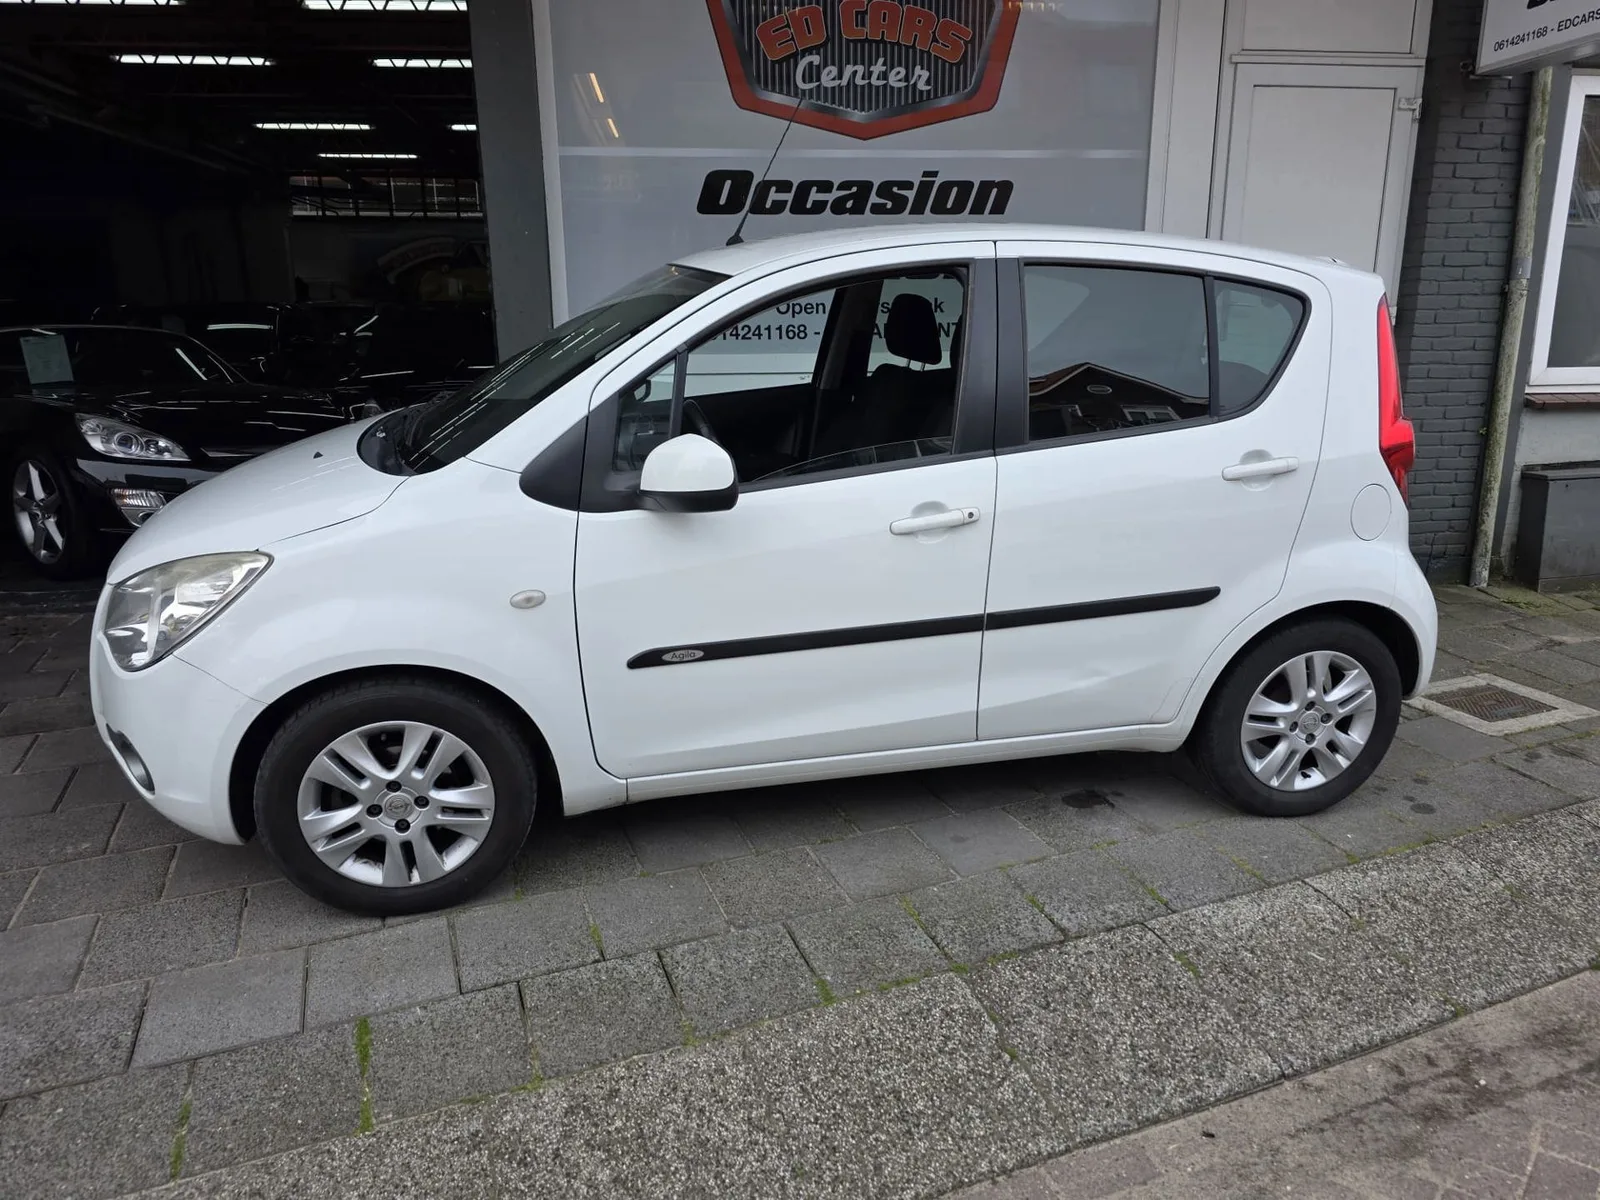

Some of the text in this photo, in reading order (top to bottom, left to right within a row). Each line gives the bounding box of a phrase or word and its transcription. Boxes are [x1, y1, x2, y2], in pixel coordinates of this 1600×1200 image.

[756, 0, 973, 63] ED CARS
[1493, 26, 1548, 52] 0614241168
[795, 54, 933, 91] Center
[696, 169, 1014, 215] Occasion
[776, 302, 827, 318] Open
[711, 324, 808, 340] 14241168
[670, 651, 696, 660] Agila
